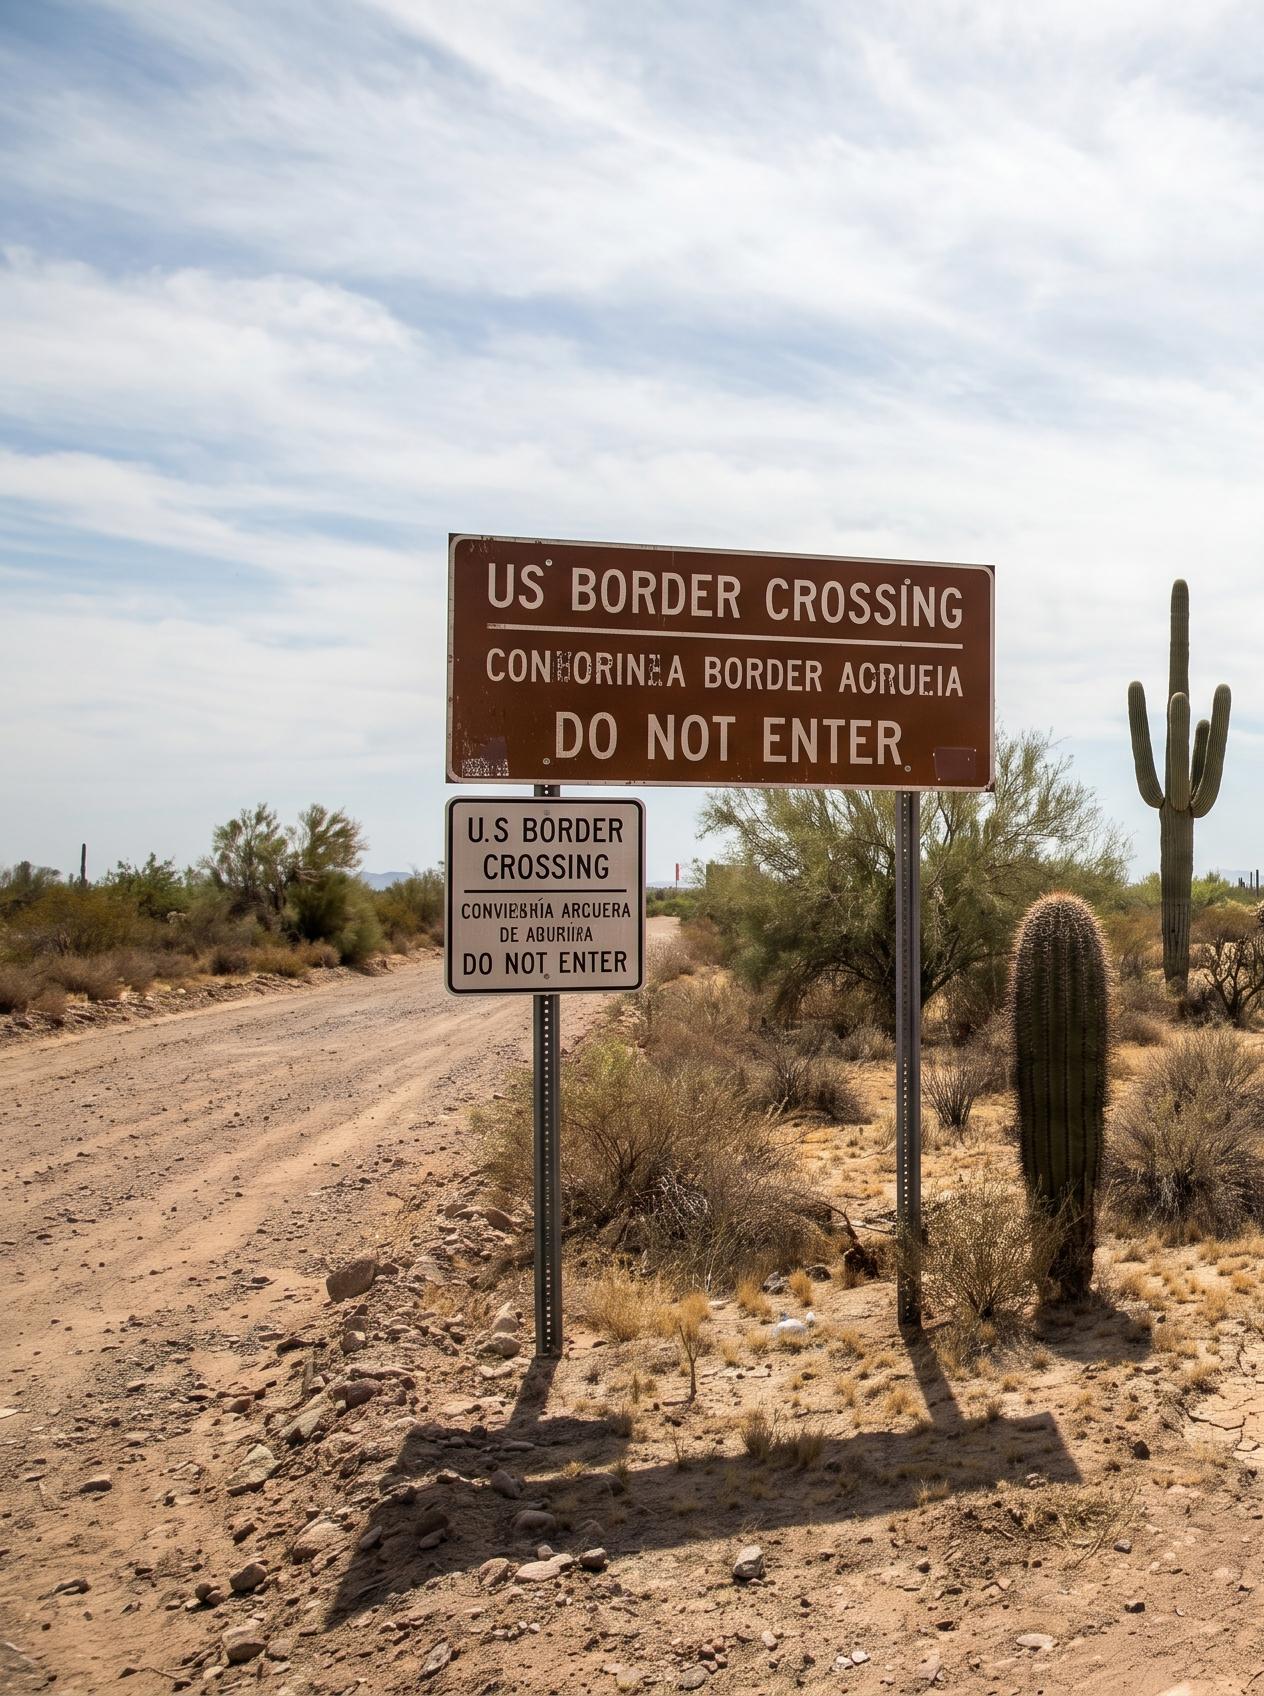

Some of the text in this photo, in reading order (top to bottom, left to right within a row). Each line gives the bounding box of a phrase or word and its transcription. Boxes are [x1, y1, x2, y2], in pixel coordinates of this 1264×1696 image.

[488, 563, 963, 629] US BORDER CROSSING
[704, 656, 823, 692] BORDER
[555, 711, 903, 766] DO NOT ENTER
[468, 817, 624, 843] U.S BORDER
[483, 853, 609, 880] CROSSING
[561, 902, 631, 919] ARCUERA
[500, 926, 519, 943] DE
[463, 950, 627, 976] DO NOT ENTER
